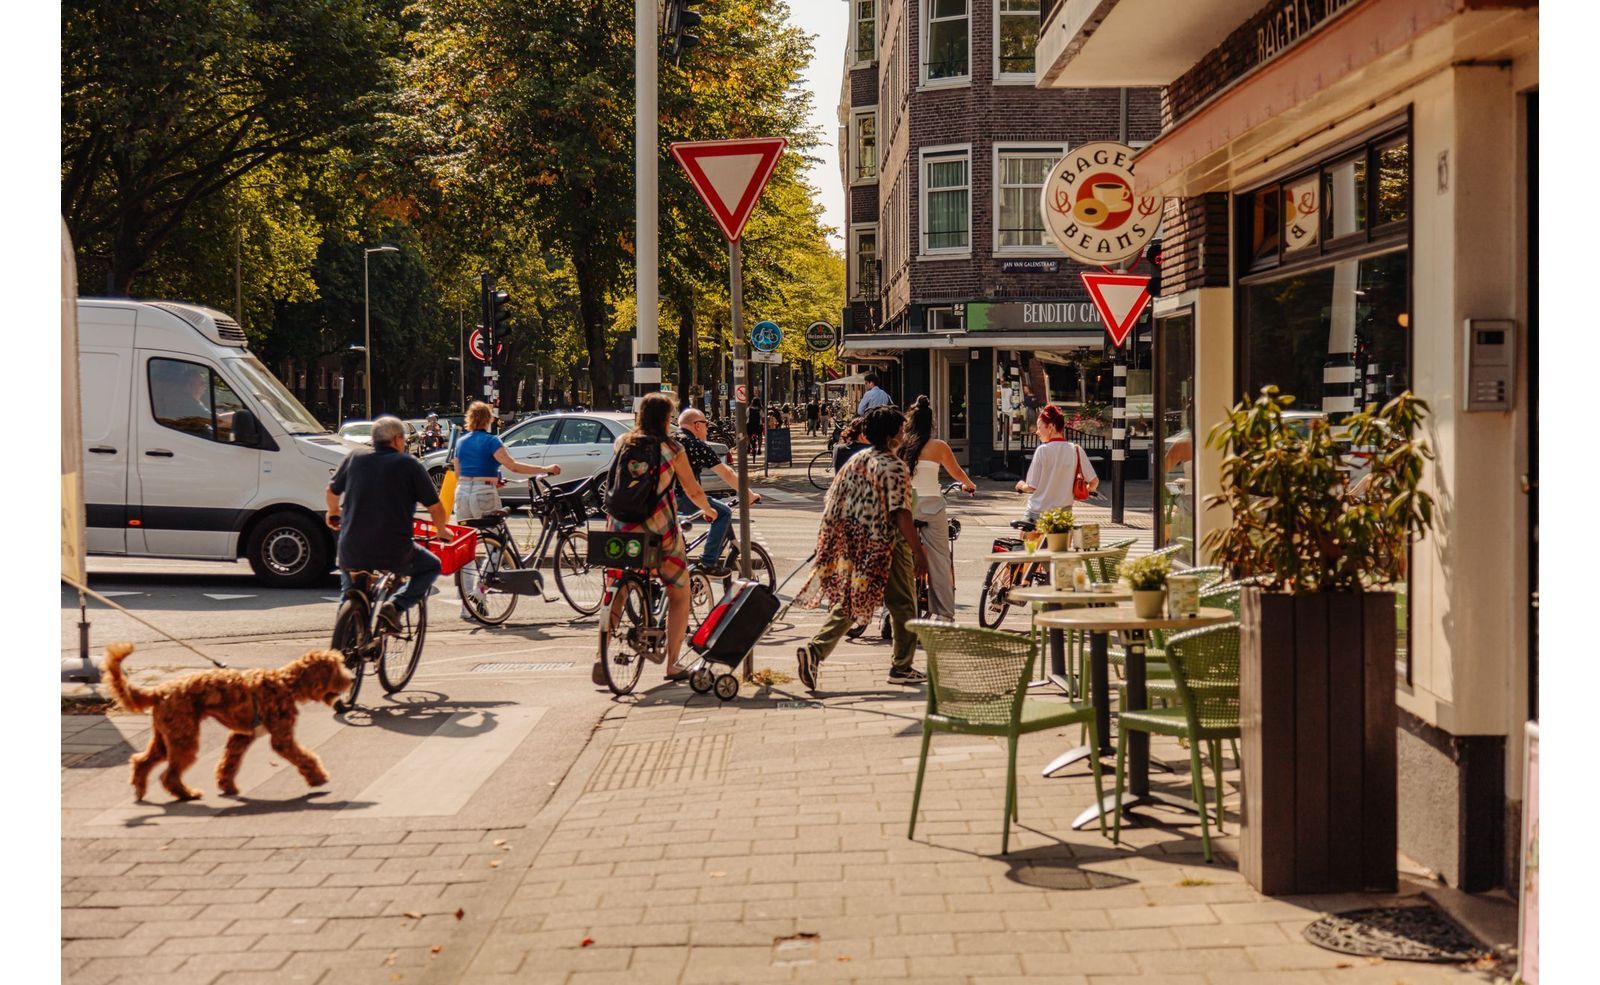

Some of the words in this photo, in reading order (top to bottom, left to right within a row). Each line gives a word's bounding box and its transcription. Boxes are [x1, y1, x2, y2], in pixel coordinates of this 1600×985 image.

[1060, 150, 1136, 184] BAGEL
[1064, 223, 1146, 253] BEANS
[1023, 303, 1076, 323] BENDITO
[1080, 303, 1100, 323] CA
